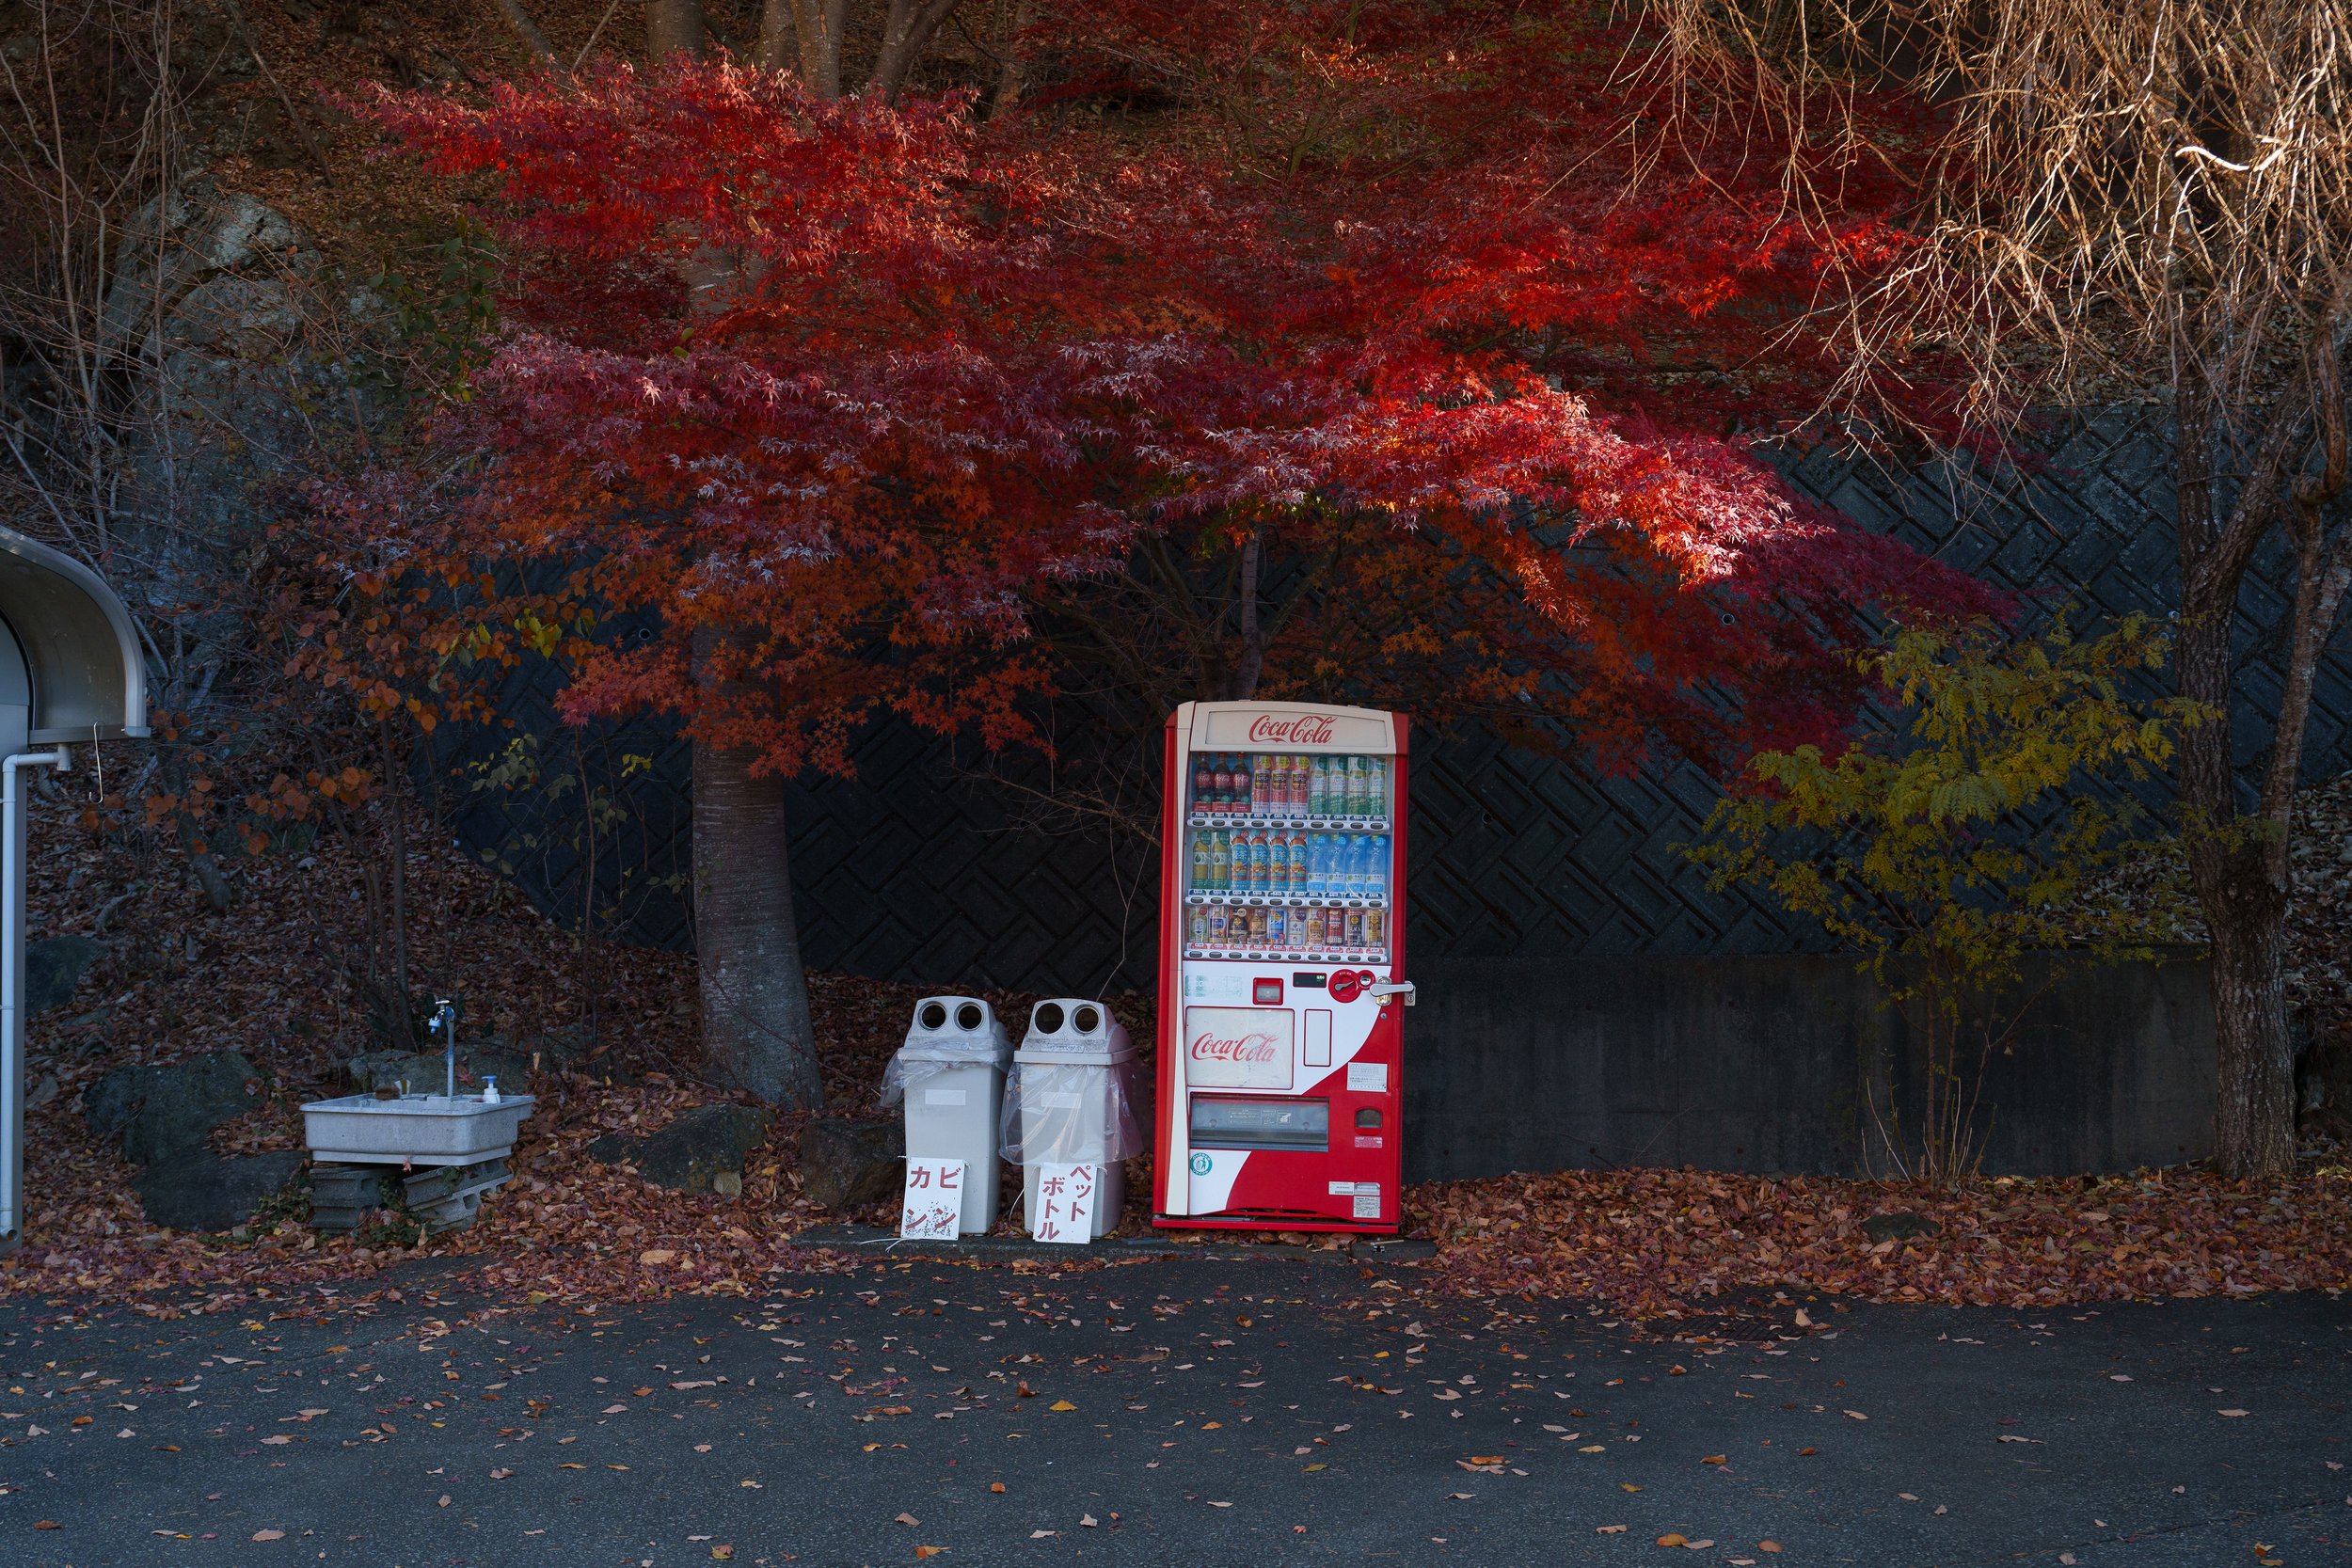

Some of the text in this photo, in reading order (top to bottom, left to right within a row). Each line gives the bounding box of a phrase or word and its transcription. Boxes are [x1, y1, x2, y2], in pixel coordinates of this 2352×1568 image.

[1248, 714, 1338, 743] Coca-Cola
[1191, 1032, 1278, 1062] Coca-Cola
[1038, 1178, 1065, 1240] ボトル
[1070, 1164, 1091, 1221] ペット
